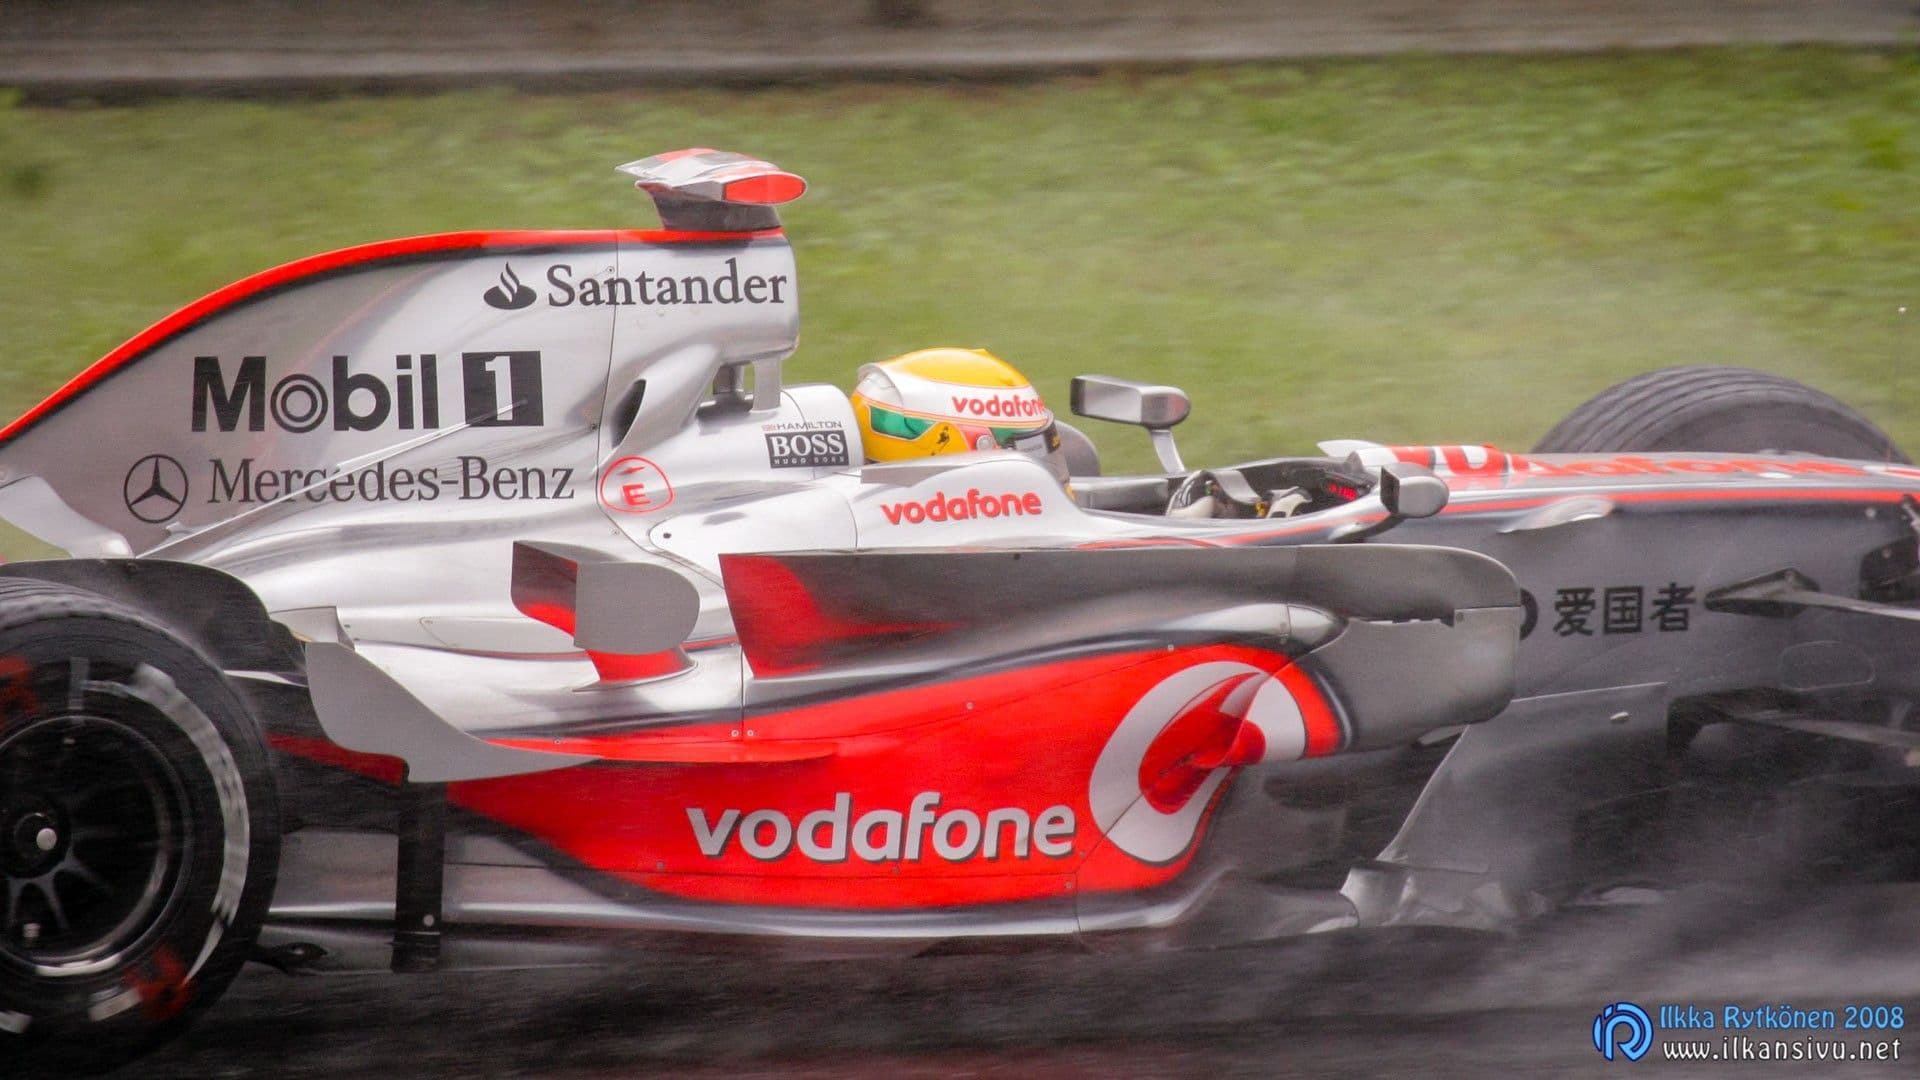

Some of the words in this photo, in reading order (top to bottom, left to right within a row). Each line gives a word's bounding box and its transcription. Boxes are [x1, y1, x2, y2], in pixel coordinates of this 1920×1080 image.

[546, 257, 787, 307] Santander
[191, 353, 439, 434] Mobil
[951, 394, 1045, 417] vodafon
[769, 433, 844, 457] BOSS
[776, 421, 843, 431] HAMILTON
[208, 456, 575, 503] Mercedes-Benz
[774, 457, 807, 465] HUGO
[623, 483, 652, 506] E
[880, 487, 1043, 526] vodafone
[1552, 582, 1697, 637] 爱国者
[685, 791, 1079, 862] vodafone
